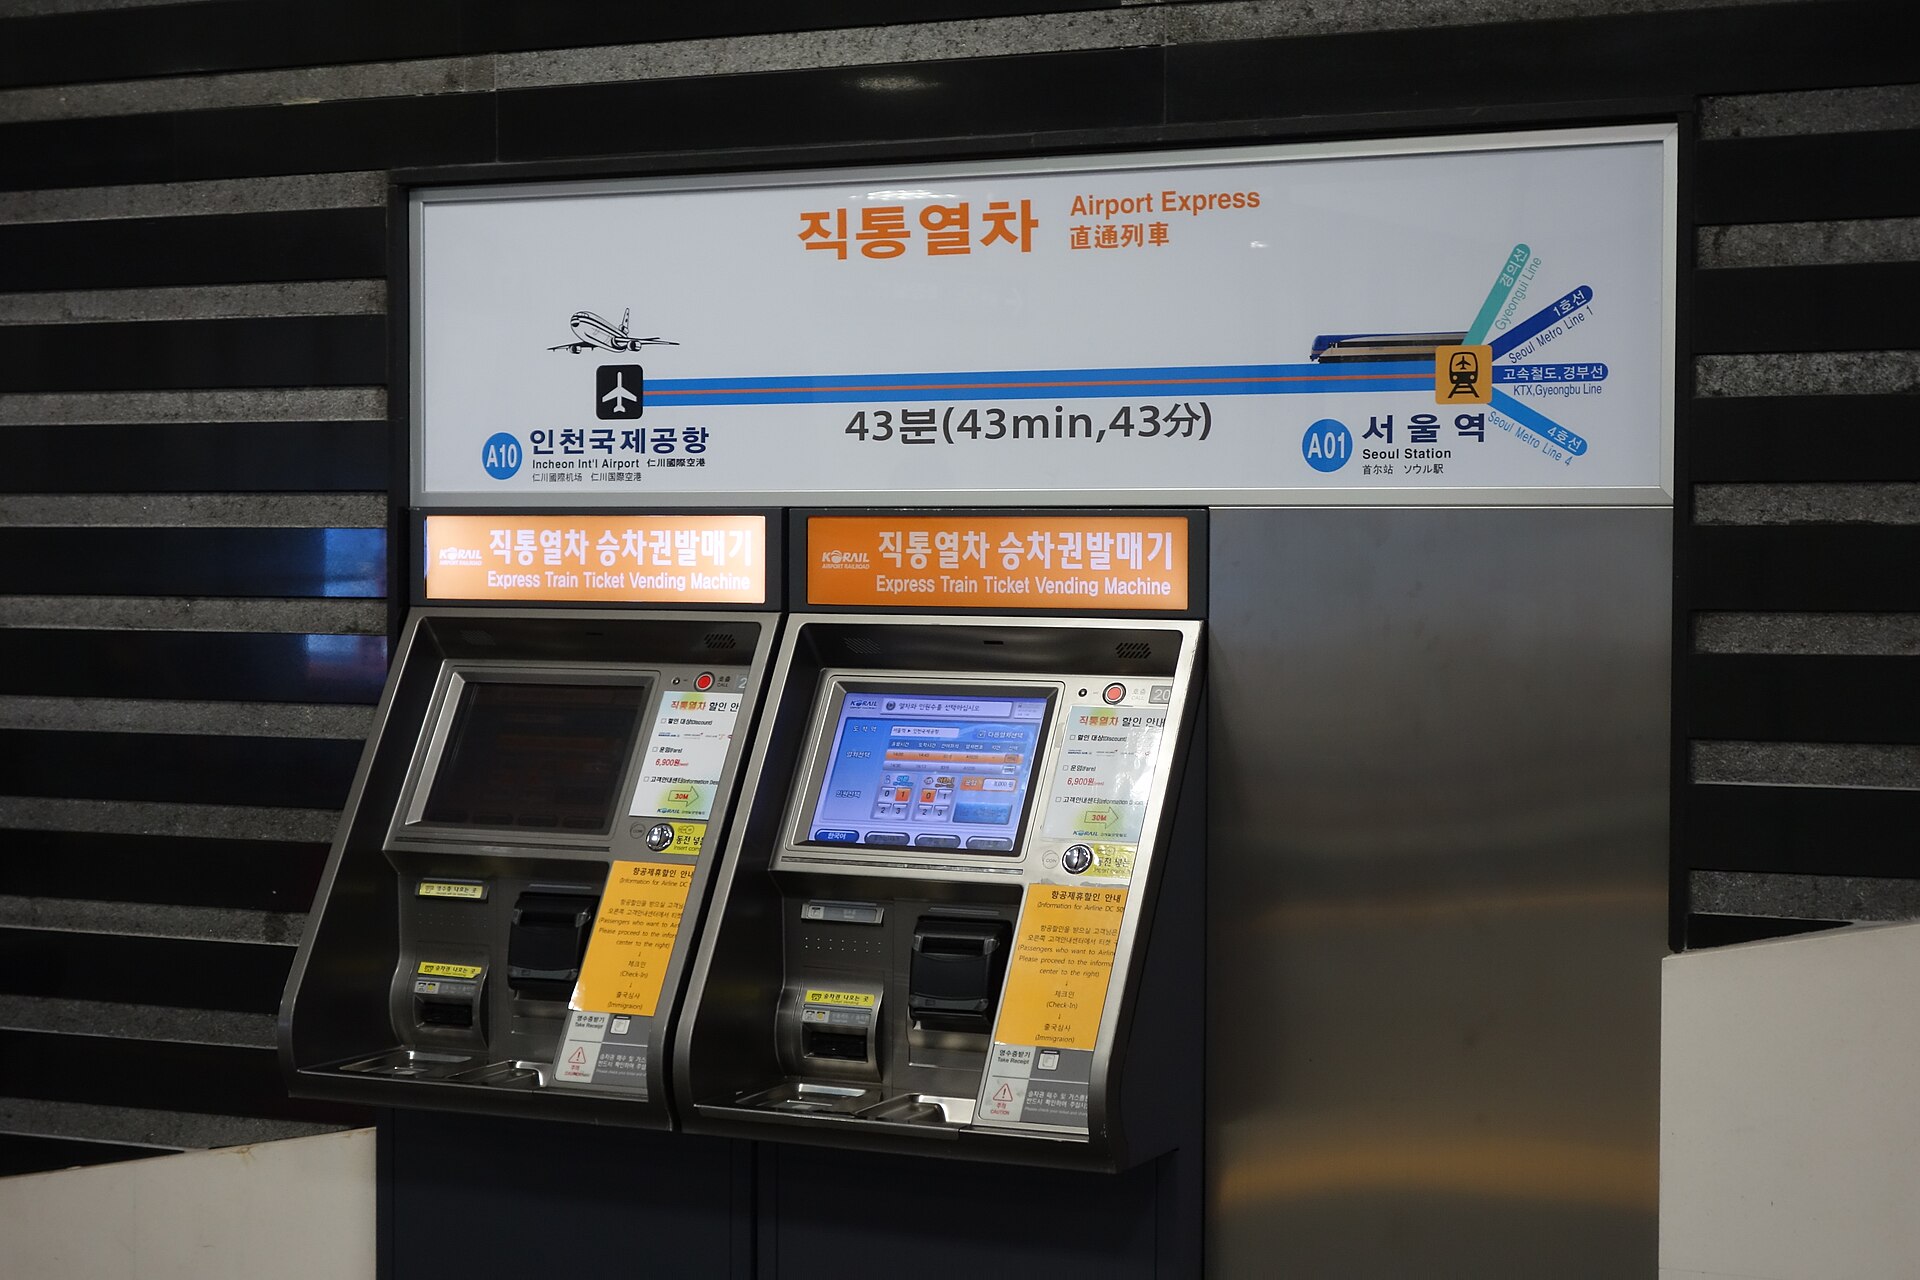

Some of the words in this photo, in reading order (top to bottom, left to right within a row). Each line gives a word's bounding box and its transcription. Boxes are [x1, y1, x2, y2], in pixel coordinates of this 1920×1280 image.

[1070, 193, 1153, 219] Airport
[1161, 190, 1261, 214] Express
[797, 199, 1039, 260] 직통열차
[1070, 221, 1170, 251] 直通列車
[1500, 248, 1529, 287] 경의선
[1494, 280, 1529, 331] Gyeongui
[1522, 256, 1542, 281] Line
[1553, 289, 1587, 317] 1호선
[1508, 341, 1536, 364] Seoul
[1537, 326, 1563, 347] Metro
[1563, 312, 1585, 330] Line
[1586, 305, 1594, 316] 1
[1503, 366, 1604, 381] 고속철도,경부선
[1513, 384, 1581, 398] KTX,Gyeongbu
[1583, 383, 1602, 395] Line
[530, 427, 710, 455] 인천국제공항
[1308, 431, 1345, 459] A01
[1488, 410, 1513, 434] Seoul
[1515, 426, 1541, 450] Metro
[1542, 442, 1562, 462] Line
[1565, 456, 1574, 467] 4
[1547, 425, 1583, 453] 4호선
[486, 443, 518, 469] A10
[532, 459, 574, 469] Incheon
[578, 459, 598, 469] Int'l
[602, 459, 640, 470] Airport
[1362, 448, 1399, 460] Seoul
[1404, 448, 1452, 459] Station
[1404, 464, 1444, 475] ソウル駅
[439, 547, 482, 560] KORAIL
[488, 529, 589, 565] 직통열차
[595, 529, 752, 567] 승차권발매기
[822, 550, 869, 563] KORAIL
[878, 530, 990, 570] 직통열차
[997, 531, 1172, 571] 승차권발매기
[487, 571, 540, 589] Express
[545, 571, 578, 588] Train
[583, 571, 625, 589] Ticket
[629, 572, 685, 591] Vending
[690, 573, 750, 590] Machine
[876, 574, 935, 595] Express
[940, 575, 978, 593] Train
[983, 575, 1030, 594] Ticket
[1035, 575, 1098, 597] Vending
[1104, 576, 1171, 595] Machine
[709, 701, 727, 712] 할인
[1079, 715, 1119, 727] 직통열차
[1122, 716, 1143, 728] 할인
[1051, 890, 1100, 902] 항공제휴할인
[1105, 893, 1122, 903] 안내
[1084, 904, 1103, 912] Airline
[1105, 905, 1115, 913] DC
[1040, 956, 1066, 965] proceed
[1077, 958, 1088, 966] the
[1055, 990, 1076, 998] 체크인
